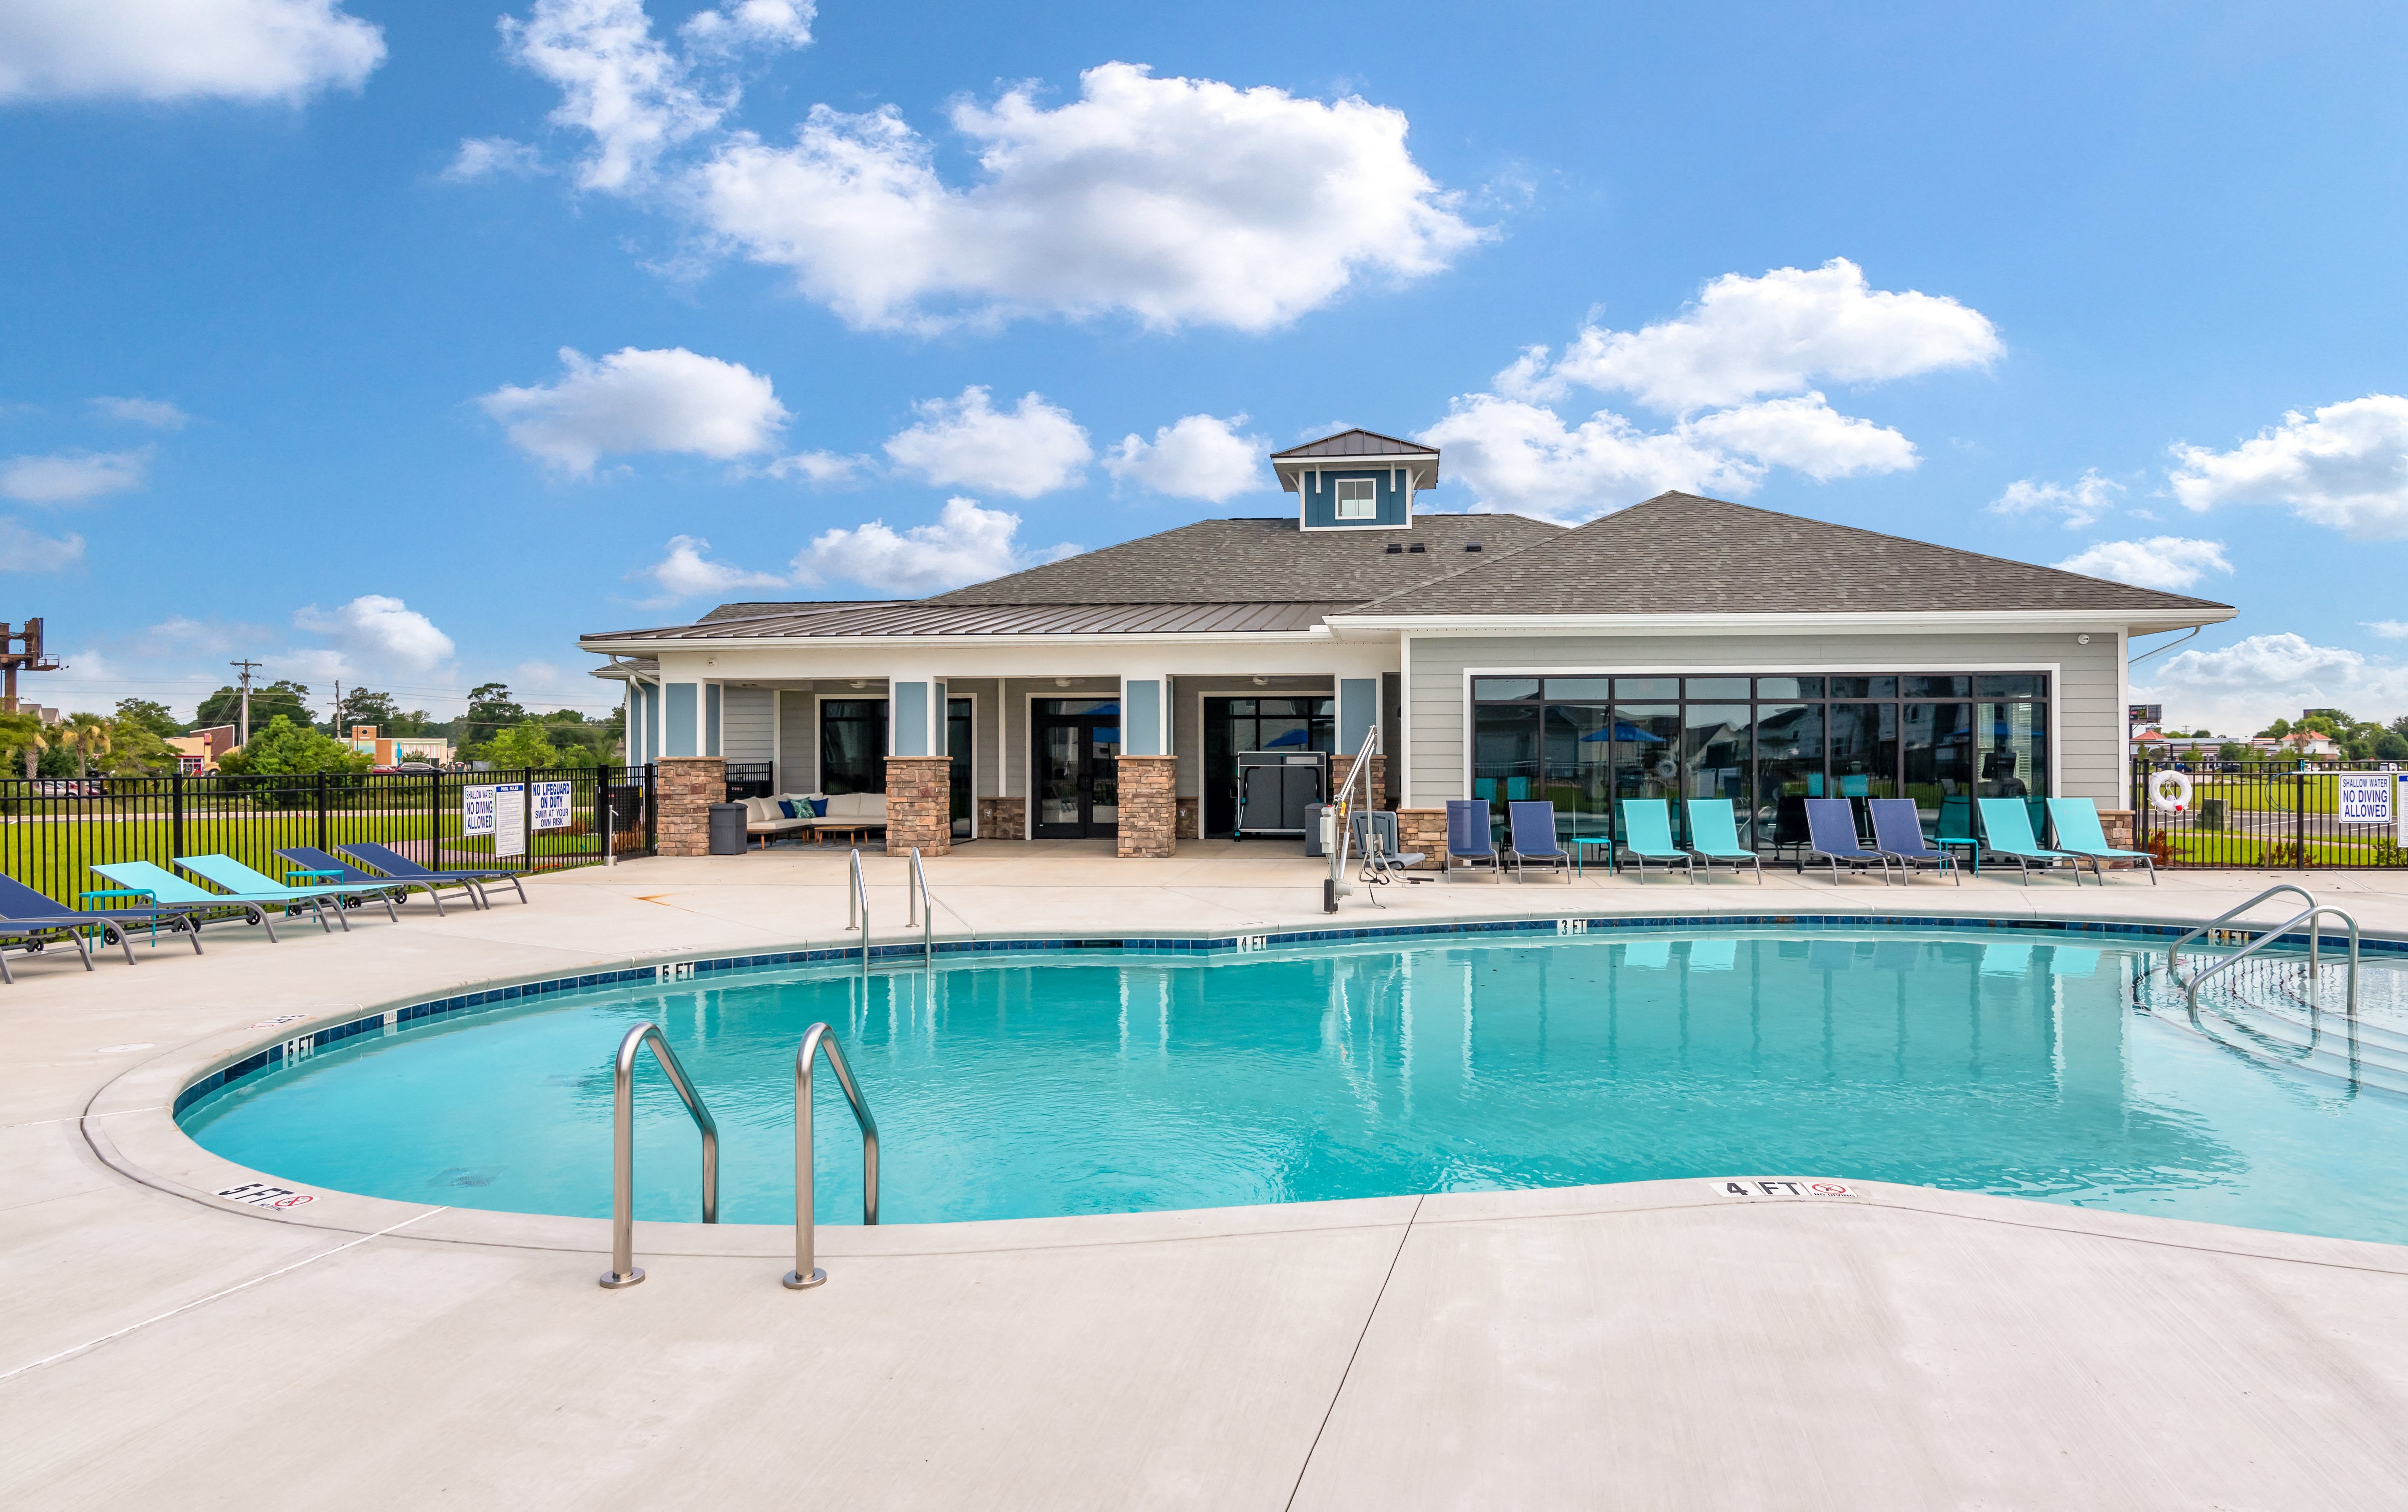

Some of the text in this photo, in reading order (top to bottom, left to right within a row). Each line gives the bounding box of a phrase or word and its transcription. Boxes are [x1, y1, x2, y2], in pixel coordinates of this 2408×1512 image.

[533, 783, 570, 796] NO LIFEGUARD
[2343, 779, 2387, 788] SHALLOW WATER
[466, 790, 493, 799] SHALLOW WATER
[2344, 790, 2387, 803] NO DIVING
[467, 801, 493, 815] NO DIVING
[541, 796, 563, 809] ON DUTY
[535, 808, 568, 819] SWIM AT YOUR
[2344, 804, 2387, 817] ALLOWED
[467, 815, 492, 829] ALLOWED
[541, 818, 551, 827] OWN
[553, 818, 563, 826] RISK
[1562, 919, 1586, 928] 3 FT
[2215, 929, 2222, 938] 3
[1252, 936, 1266, 945] FT
[662, 962, 693, 975] 5 FT
[288, 1034, 313, 1056] 5 FT
[218, 1183, 295, 1203] 5 FT
[1727, 1182, 1800, 1196] 4 FT
